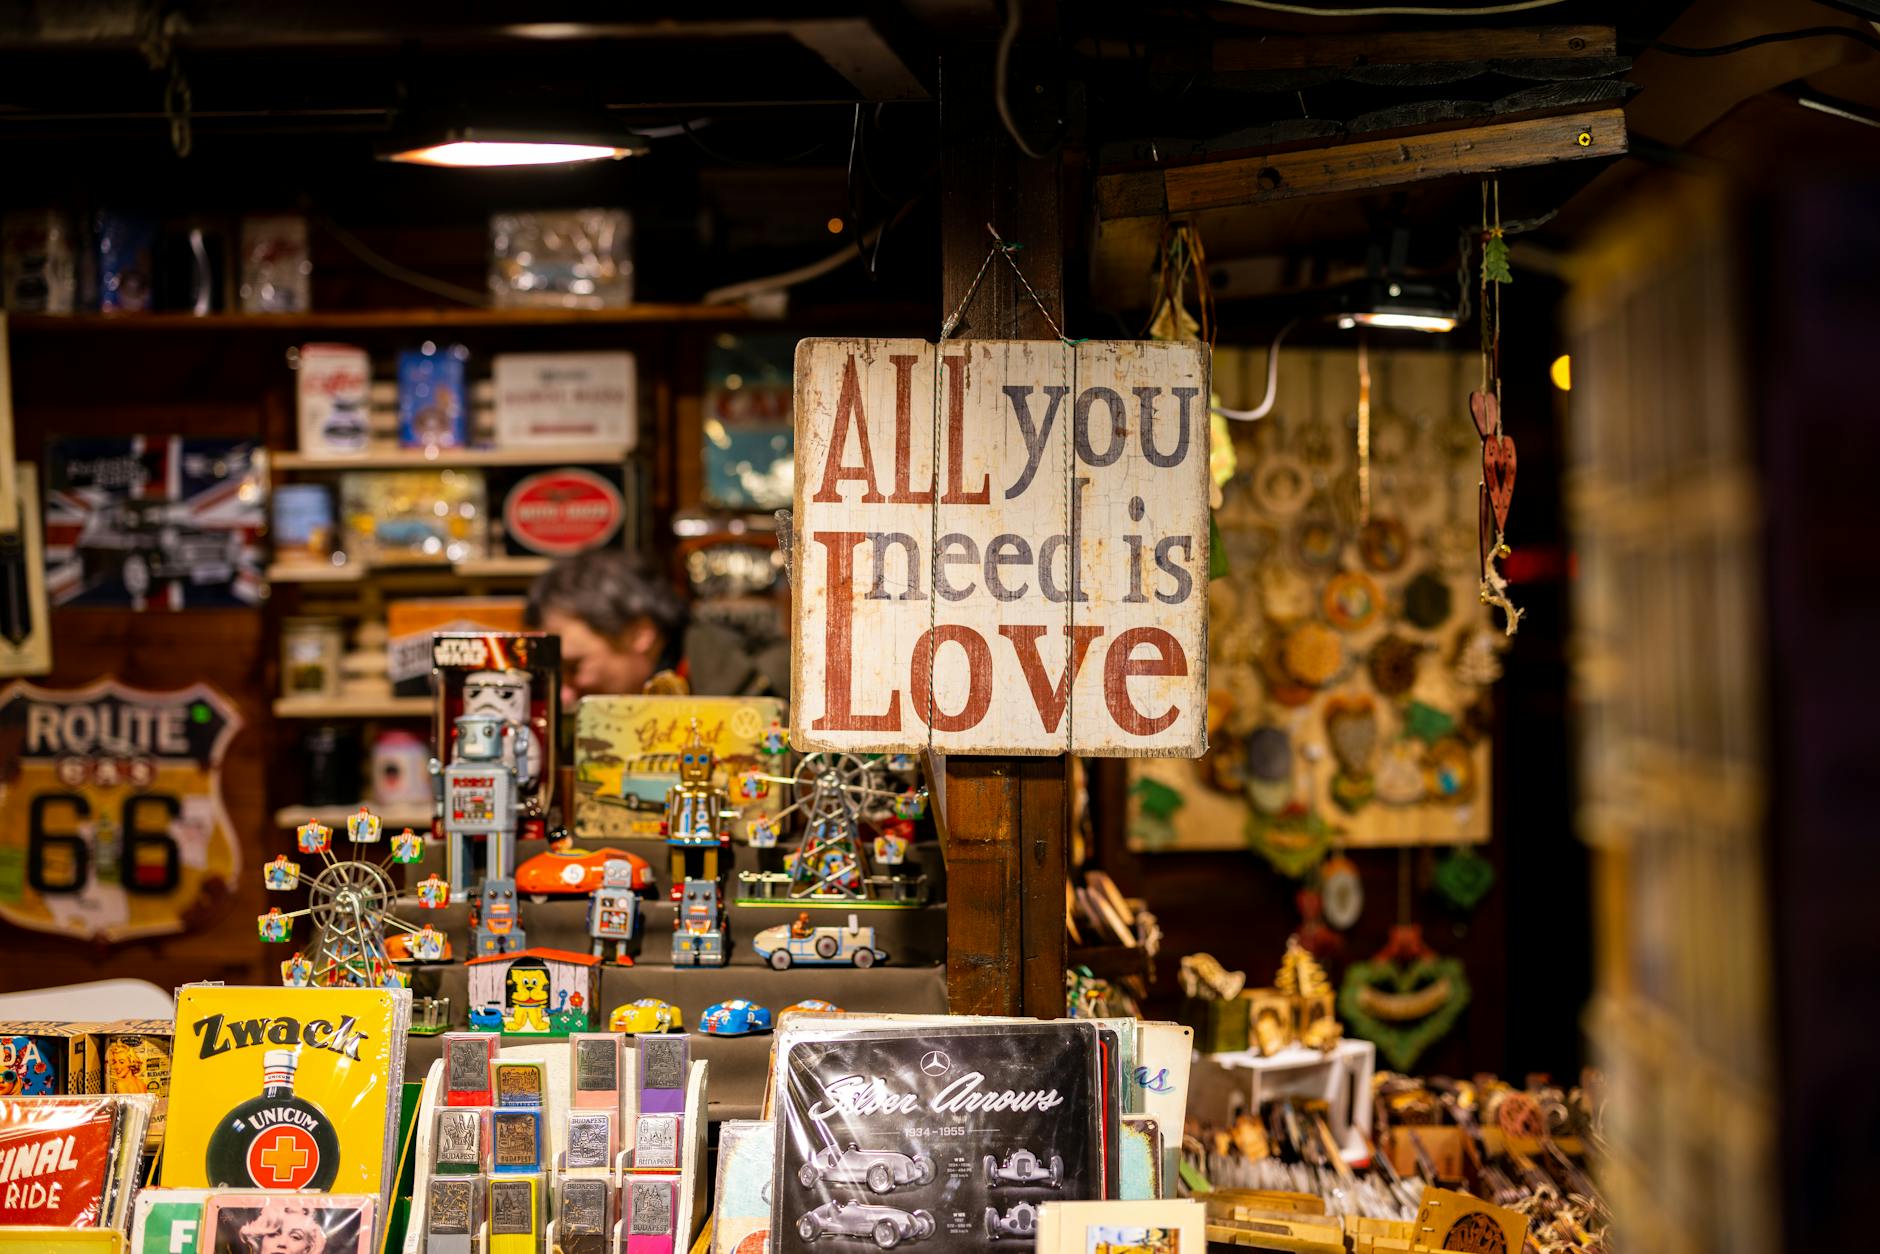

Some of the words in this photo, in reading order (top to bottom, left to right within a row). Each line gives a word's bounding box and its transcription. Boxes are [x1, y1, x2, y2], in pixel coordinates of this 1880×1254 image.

[864, 477, 1090, 603] need
[1122, 495, 1193, 604] is
[812, 531, 1188, 736] Love
[28, 703, 190, 752] ROUTE
[453, 777, 494, 788] ROBOT
[29, 794, 181, 894] 66
[193, 1013, 369, 1062] Zwack
[247, 1107, 319, 1131] UNICUM
[808, 1074, 918, 1121] Silver
[931, 1071, 1063, 1115] Arrows
[0, 1134, 78, 1184] INAL
[441, 1152, 475, 1160] BUDAPEST
[501, 1155, 532, 1163] BUDAPEST
[4, 1181, 62, 1210] RIDE
